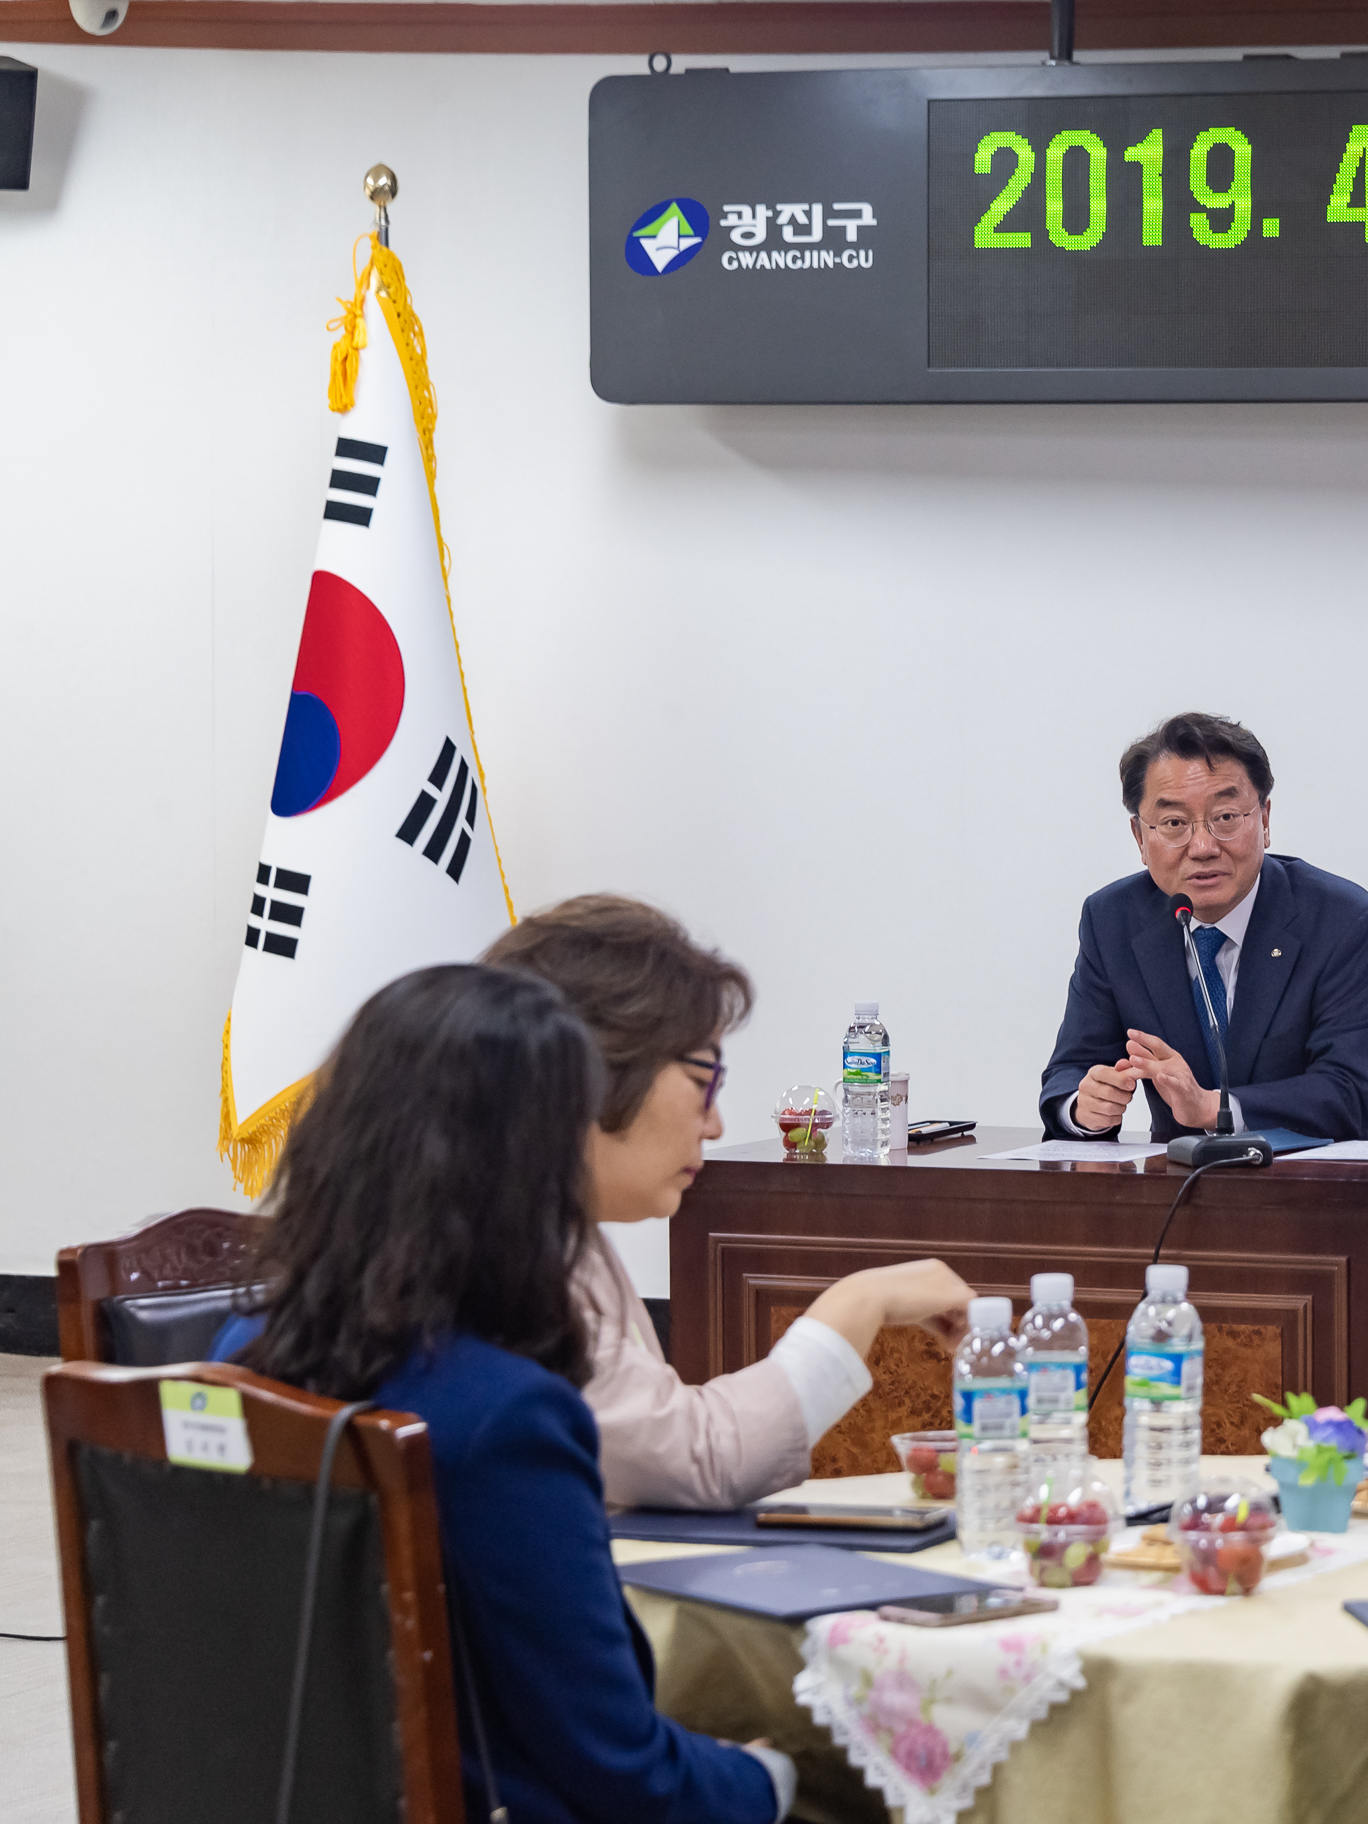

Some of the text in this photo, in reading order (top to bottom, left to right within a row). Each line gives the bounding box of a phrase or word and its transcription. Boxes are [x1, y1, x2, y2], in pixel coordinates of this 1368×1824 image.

[974, 126, 1280, 250] 2019.
[719, 202, 878, 246] 광진구
[721, 249, 874, 271] GWANGJIN-GU
